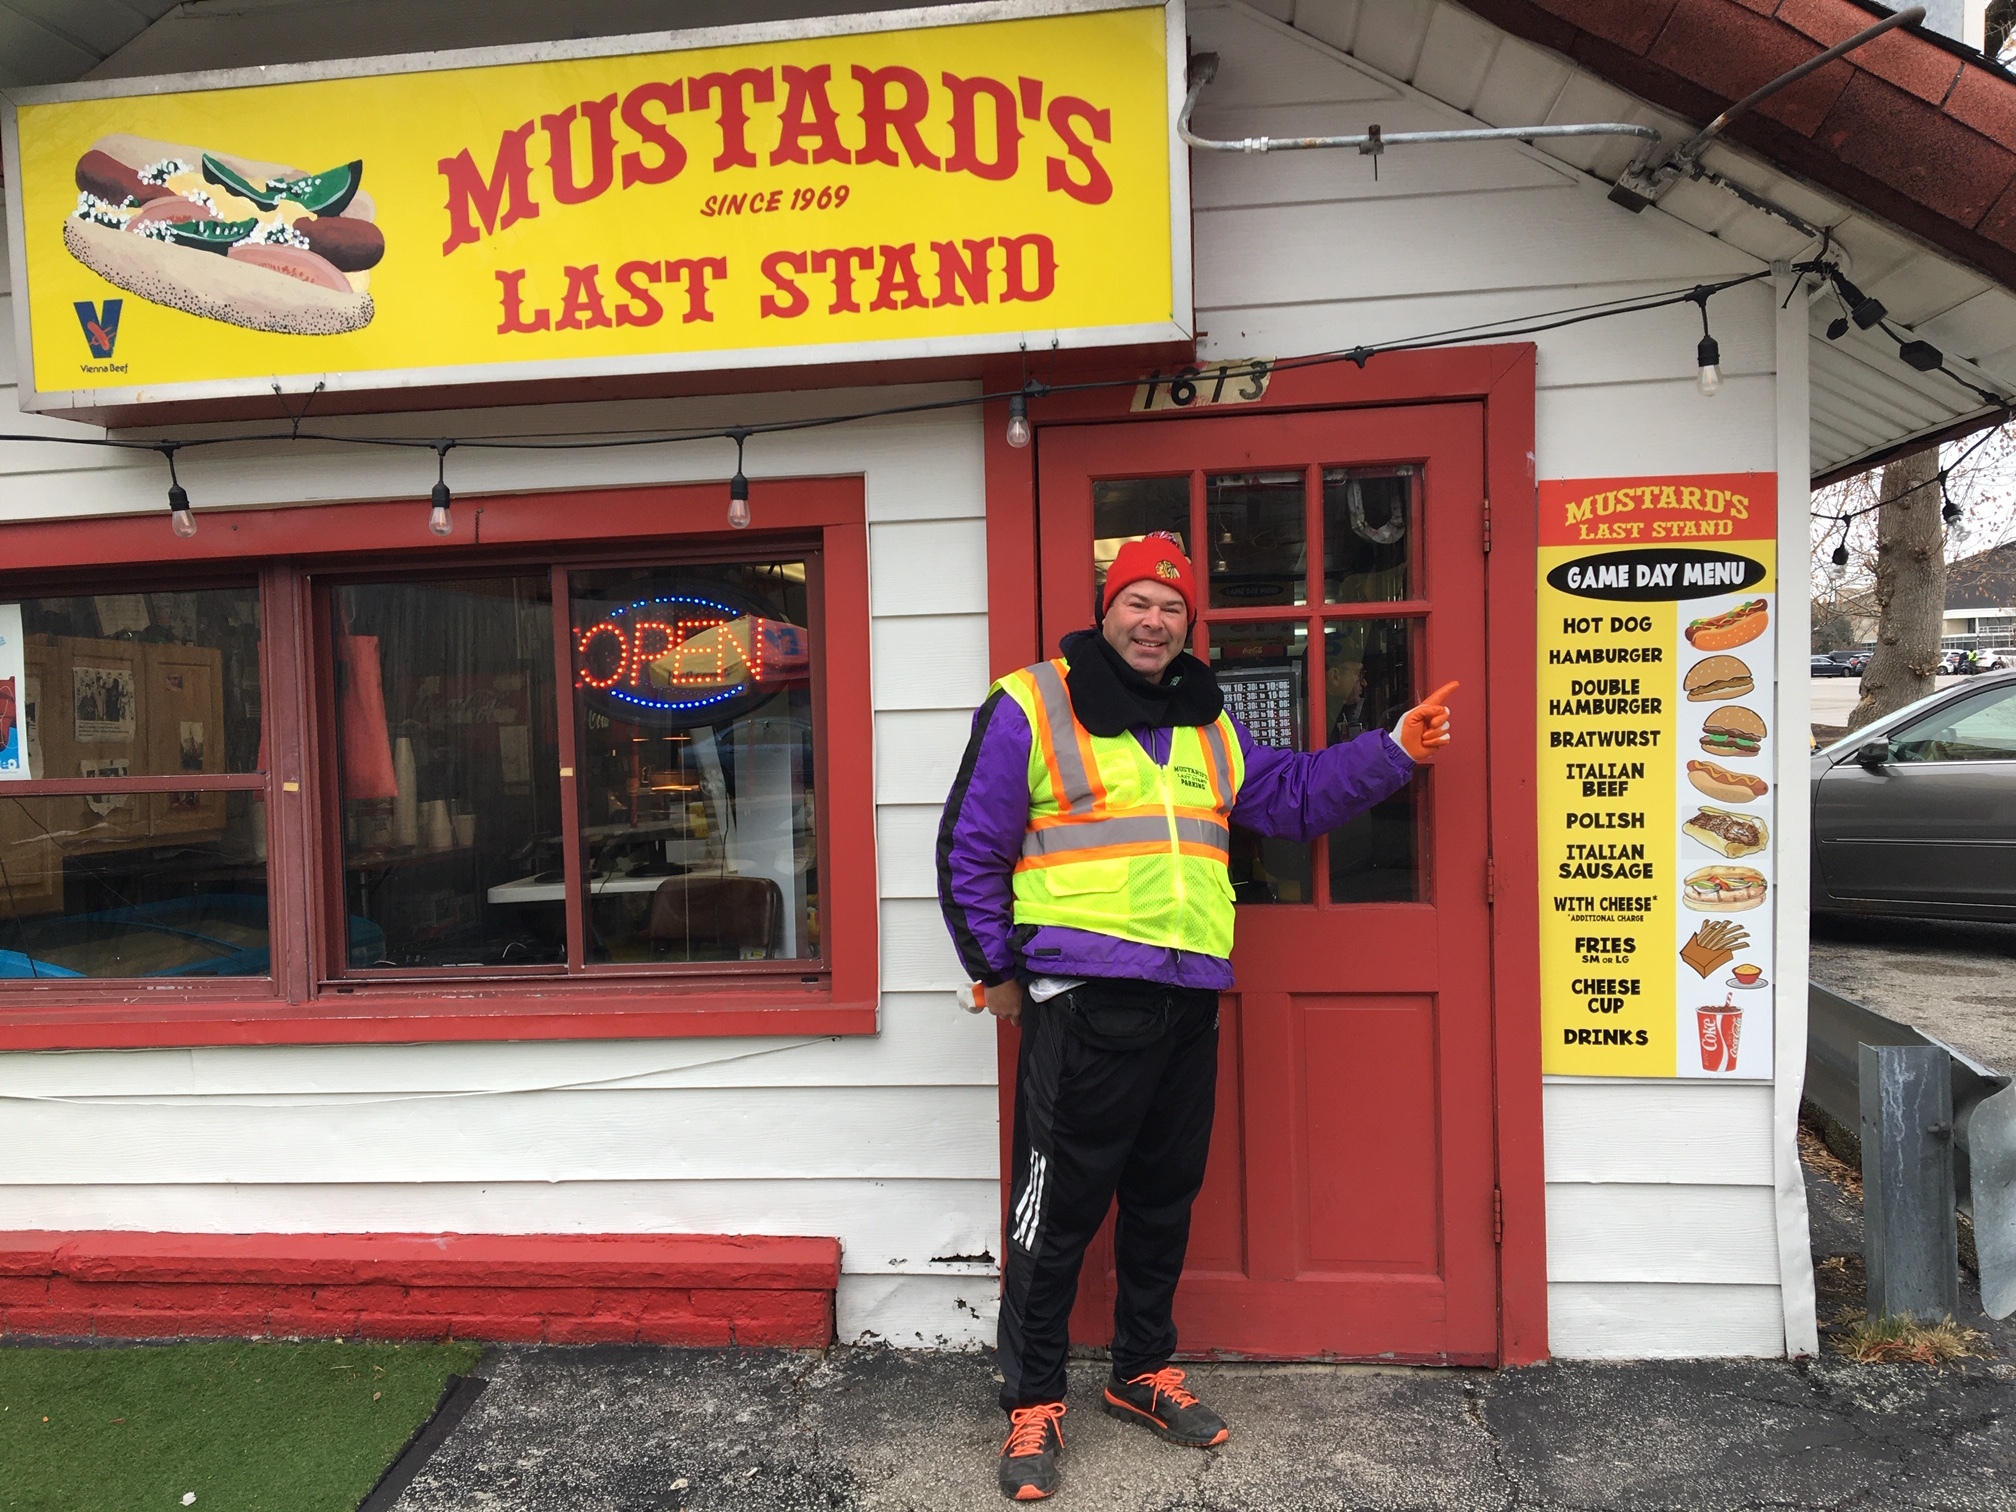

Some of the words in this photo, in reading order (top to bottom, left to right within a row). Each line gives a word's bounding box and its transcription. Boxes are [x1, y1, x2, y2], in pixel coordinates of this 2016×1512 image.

[438, 64, 1112, 255] MUSTARD'S
[700, 190, 782, 217] SINCE
[790, 184, 850, 212] 1969
[496, 256, 728, 334] LAST
[760, 233, 1059, 319] STAND
[80, 365, 108, 374] Vienna
[109, 363, 128, 374] Beef
[1144, 361, 1268, 409] 1613
[1565, 485, 1749, 527] MUSTARD'S
[1579, 521, 1644, 540] LAST
[1652, 519, 1733, 538] STAND
[1567, 564, 1630, 589] GAME
[1636, 563, 1679, 588] DAY
[1682, 561, 1746, 586] MENU
[1563, 617, 1603, 634] HOT
[1610, 616, 1653, 633] DOG
[578, 617, 764, 687] OPEN
[1549, 648, 1663, 665] HAMBURGER
[1571, 679, 1640, 696] DOUBLE
[1549, 698, 1662, 715] HAMBURGER
[1550, 731, 1661, 748] BRATWURST
[1566, 763, 1645, 780] ITALIAN
[1181, 778, 1206, 790] PARKING
[1582, 781, 1629, 798] BEEF
[1566, 812, 1645, 829] POLISH
[1566, 844, 1645, 861] ITALIAN
[1559, 863, 1653, 879] SAUSAGE
[1554, 896, 1595, 912] WITH
[1617, 914, 1644, 922] CHARGE
[1575, 937, 1637, 954] FRIES
[1582, 955, 1600, 964] SM
[1615, 955, 1630, 964] LG
[1571, 979, 1641, 996] CHEESE
[1587, 997, 1625, 1014] CUP
[1563, 1029, 1649, 1046] DRINKS
[1702, 1018, 1717, 1051] Coke
